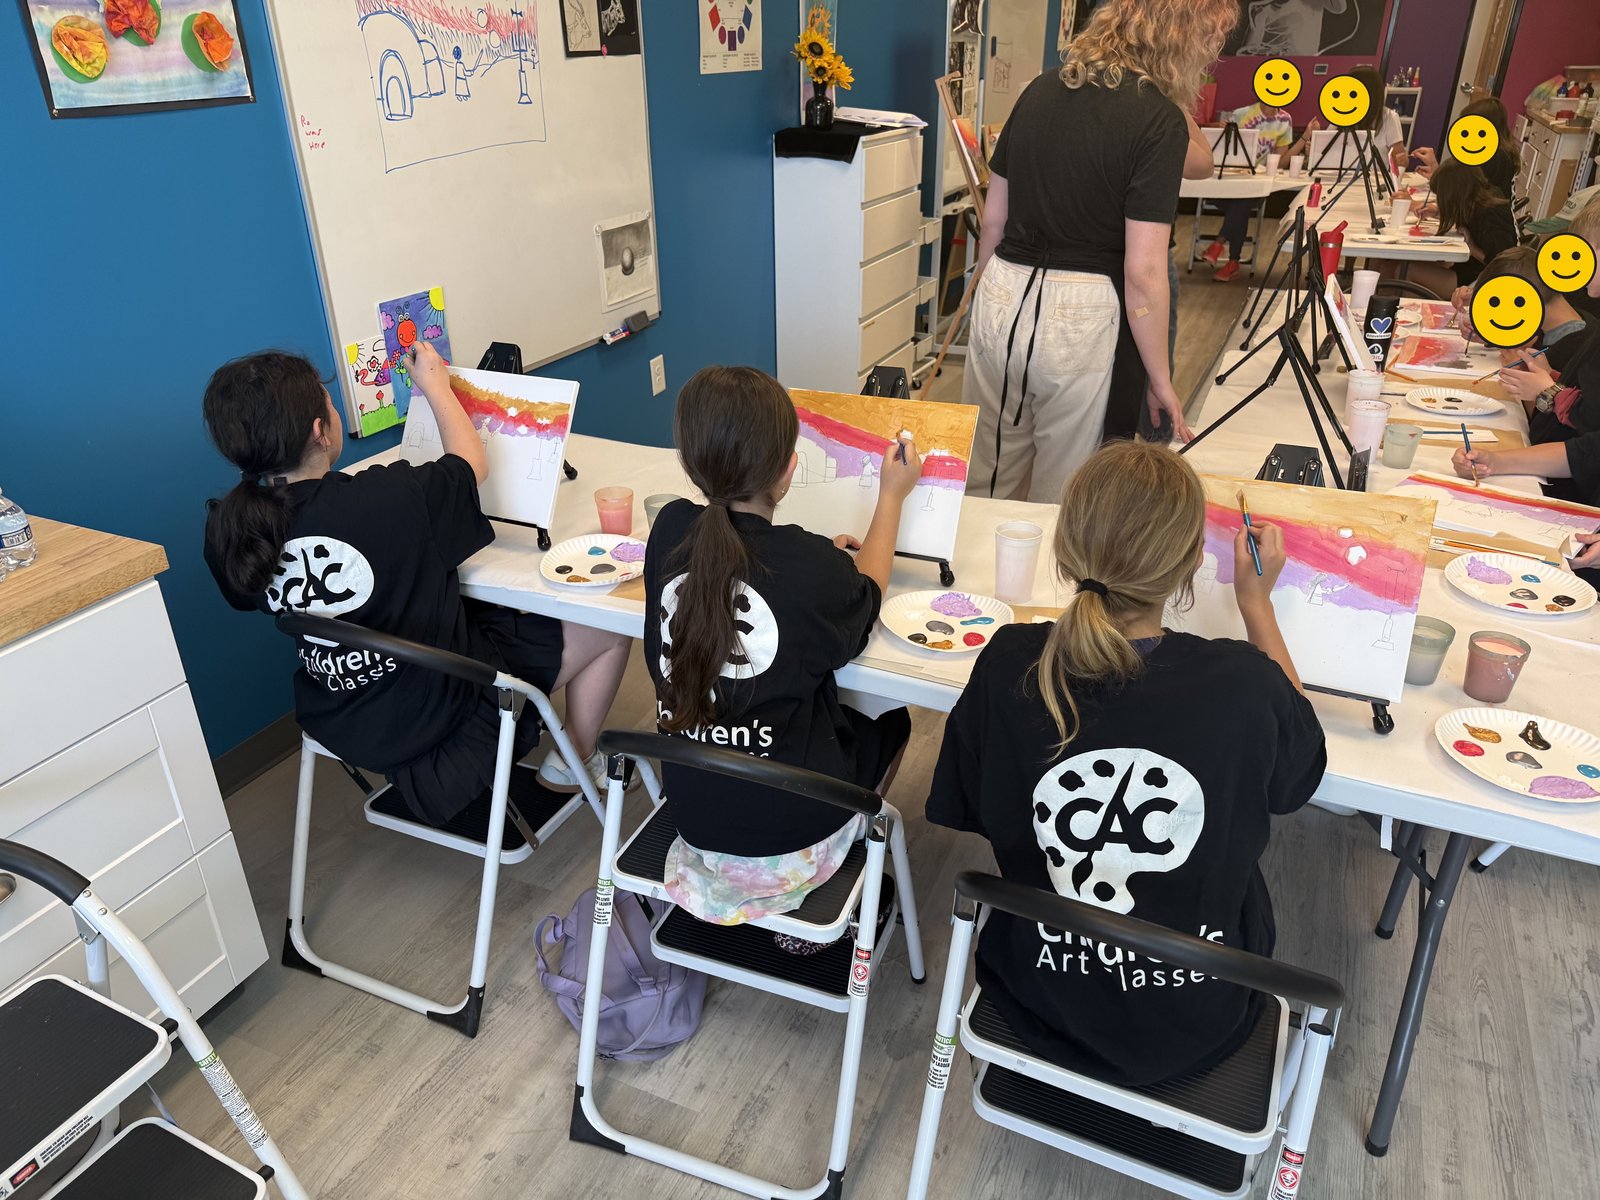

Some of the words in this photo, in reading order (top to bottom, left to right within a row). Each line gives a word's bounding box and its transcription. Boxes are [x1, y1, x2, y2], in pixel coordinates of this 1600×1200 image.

[1055, 761, 1178, 855] CAC
[1036, 944, 1089, 974] Art
[1104, 965, 1218, 991] lasse
